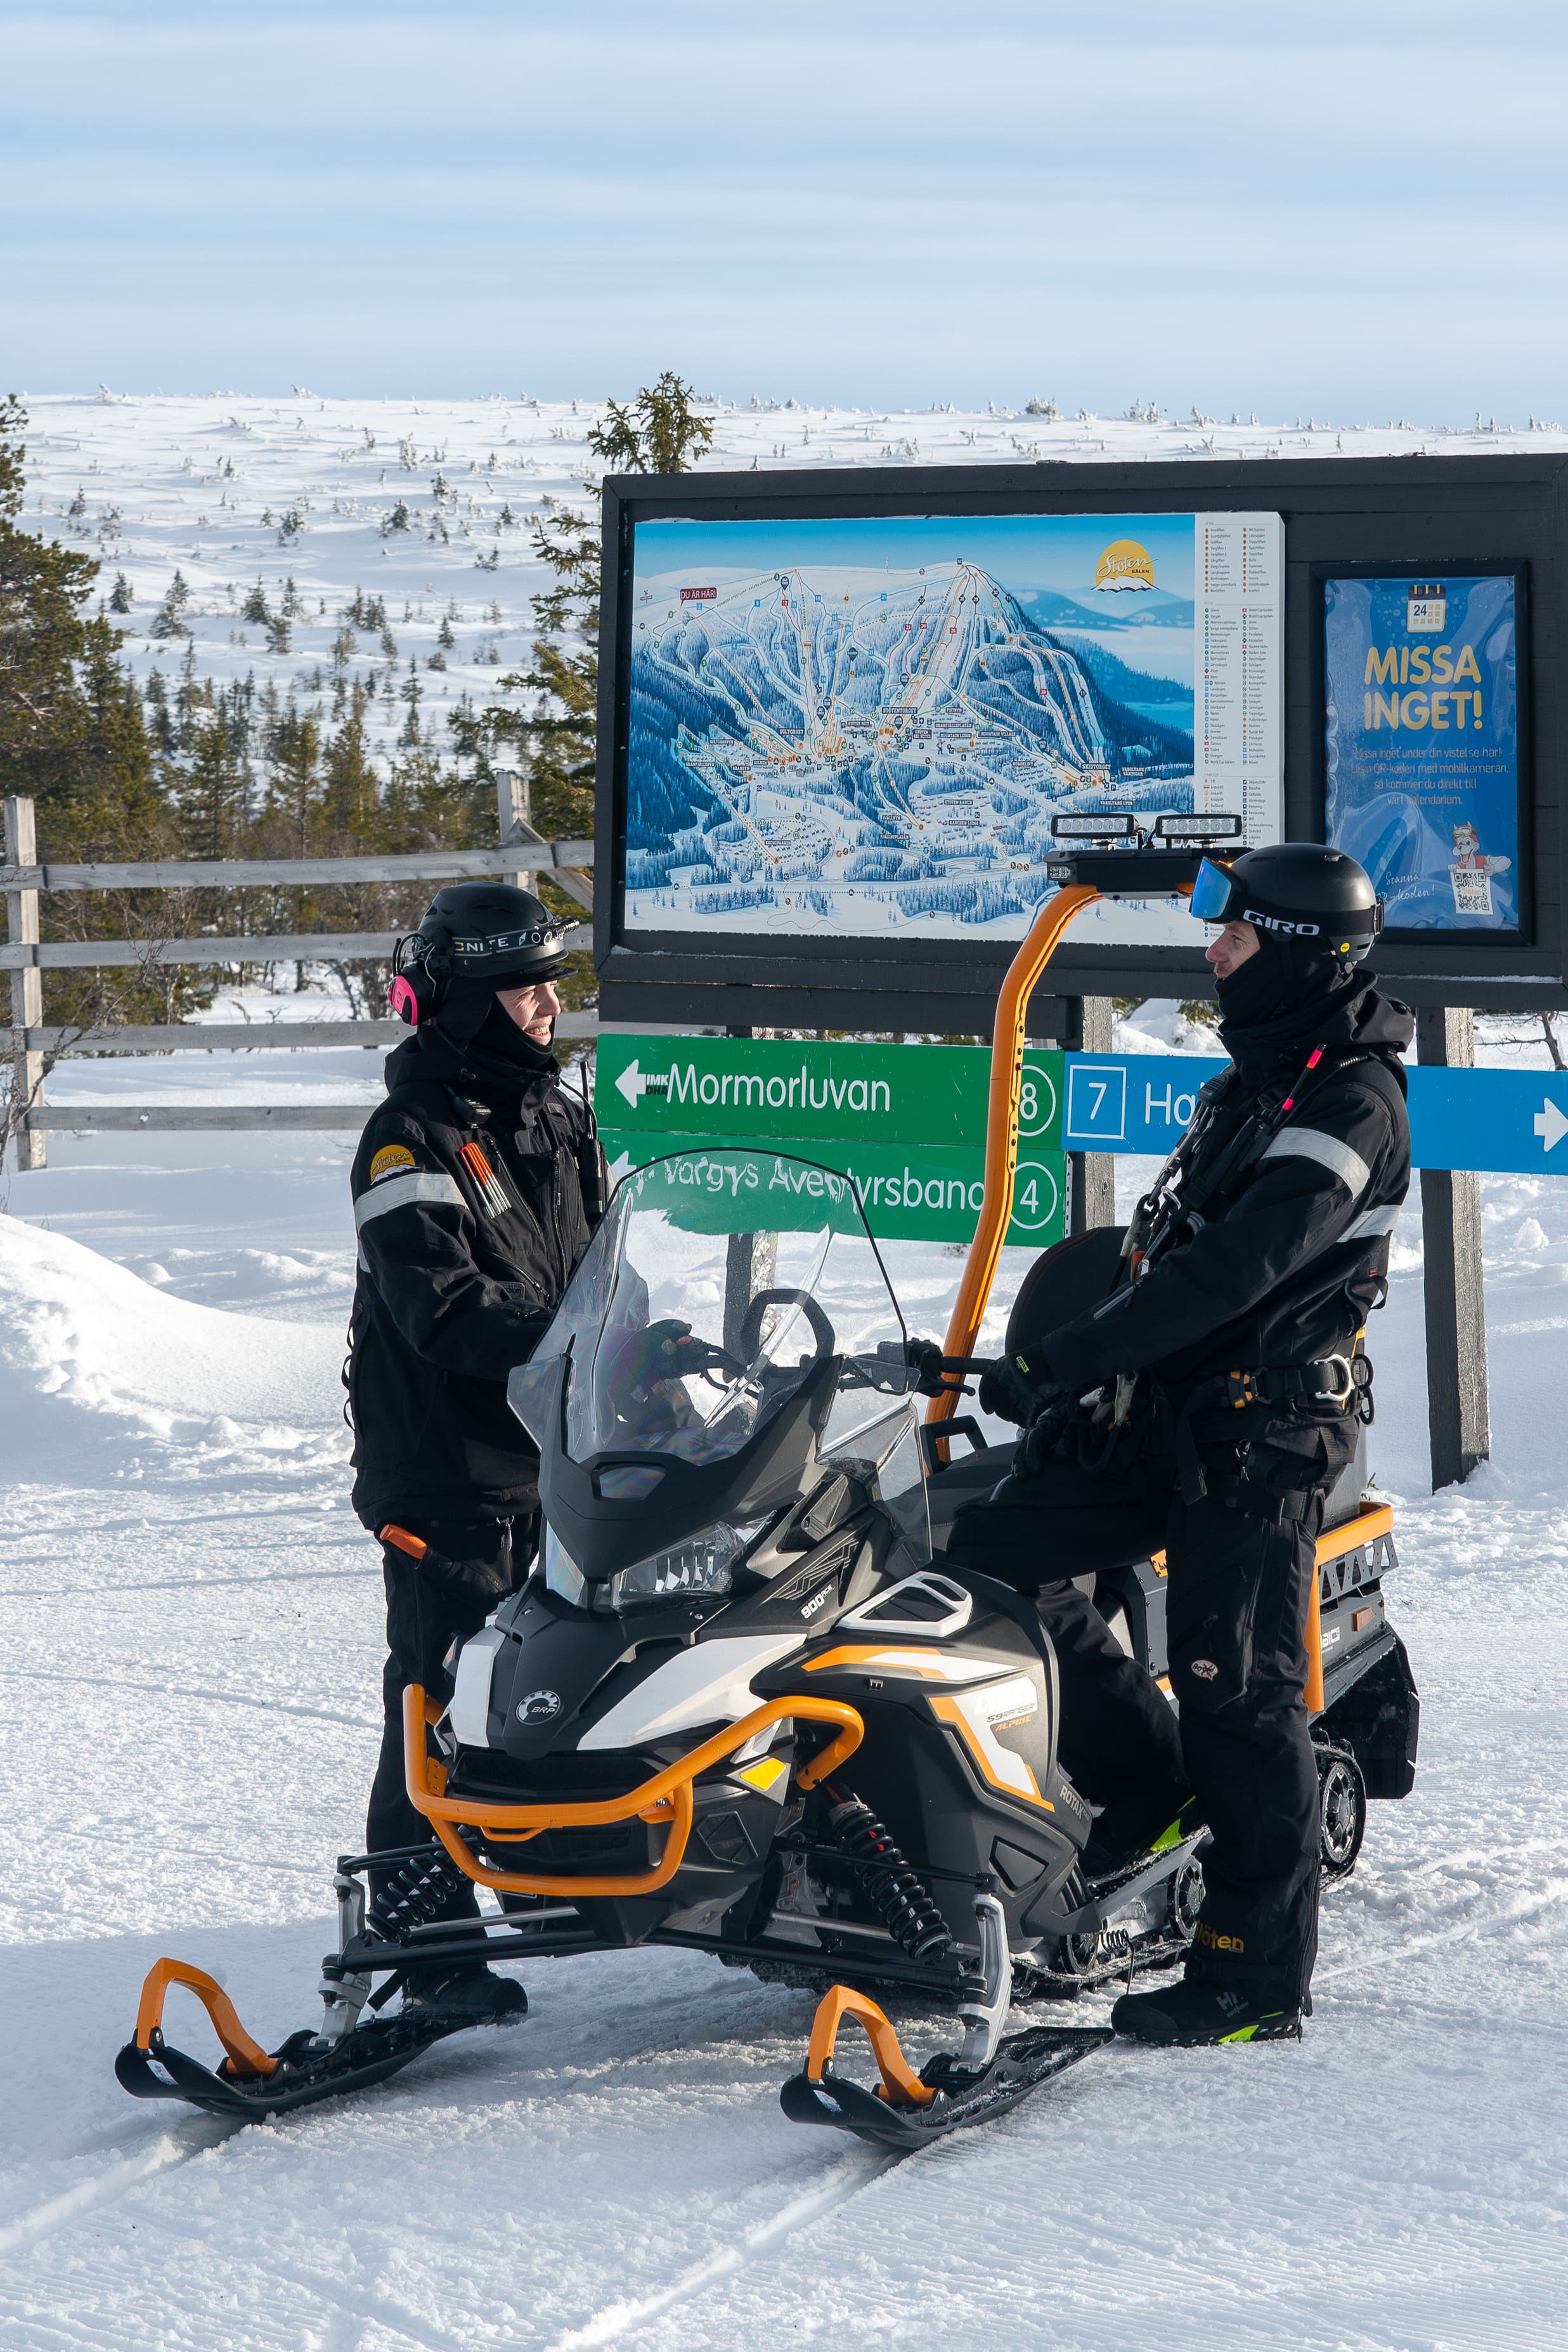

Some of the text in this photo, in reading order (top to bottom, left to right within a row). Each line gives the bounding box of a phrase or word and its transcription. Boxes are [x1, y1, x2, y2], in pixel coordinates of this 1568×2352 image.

[692, 590, 700, 599] ÄR
[701, 589, 716, 598] HÄR!
[1413, 604, 1427, 616] 24
[1364, 644, 1482, 685] MISSA
[1364, 690, 1483, 731] INGET!
[1402, 748, 1427, 758] under
[1429, 747, 1441, 758] din
[1482, 746, 1503, 758] här!
[1373, 763, 1416, 774] QR-koden
[1418, 763, 1437, 774] med
[1439, 763, 1508, 774] mobilkameran,
[1385, 779, 1422, 789] kommer
[1425, 779, 1435, 789] du
[1437, 779, 1462, 789] direkt
[1465, 779, 1477, 789] till
[1385, 871, 1420, 886] Scanna
[1243, 909, 1320, 936] GIRO
[645, 1085, 668, 1096] DHA
[647, 1074, 669, 1086] IMK
[666, 1063, 890, 1112] Mormorluvan
[1020, 1082, 1038, 1120] 8
[1088, 1082, 1107, 1121] 7
[1020, 1179, 1039, 1214] 4
[801, 1593, 825, 1619] 900
[995, 1714, 1033, 1732] ALPINE
[1059, 1784, 1084, 1820] ROTAX
